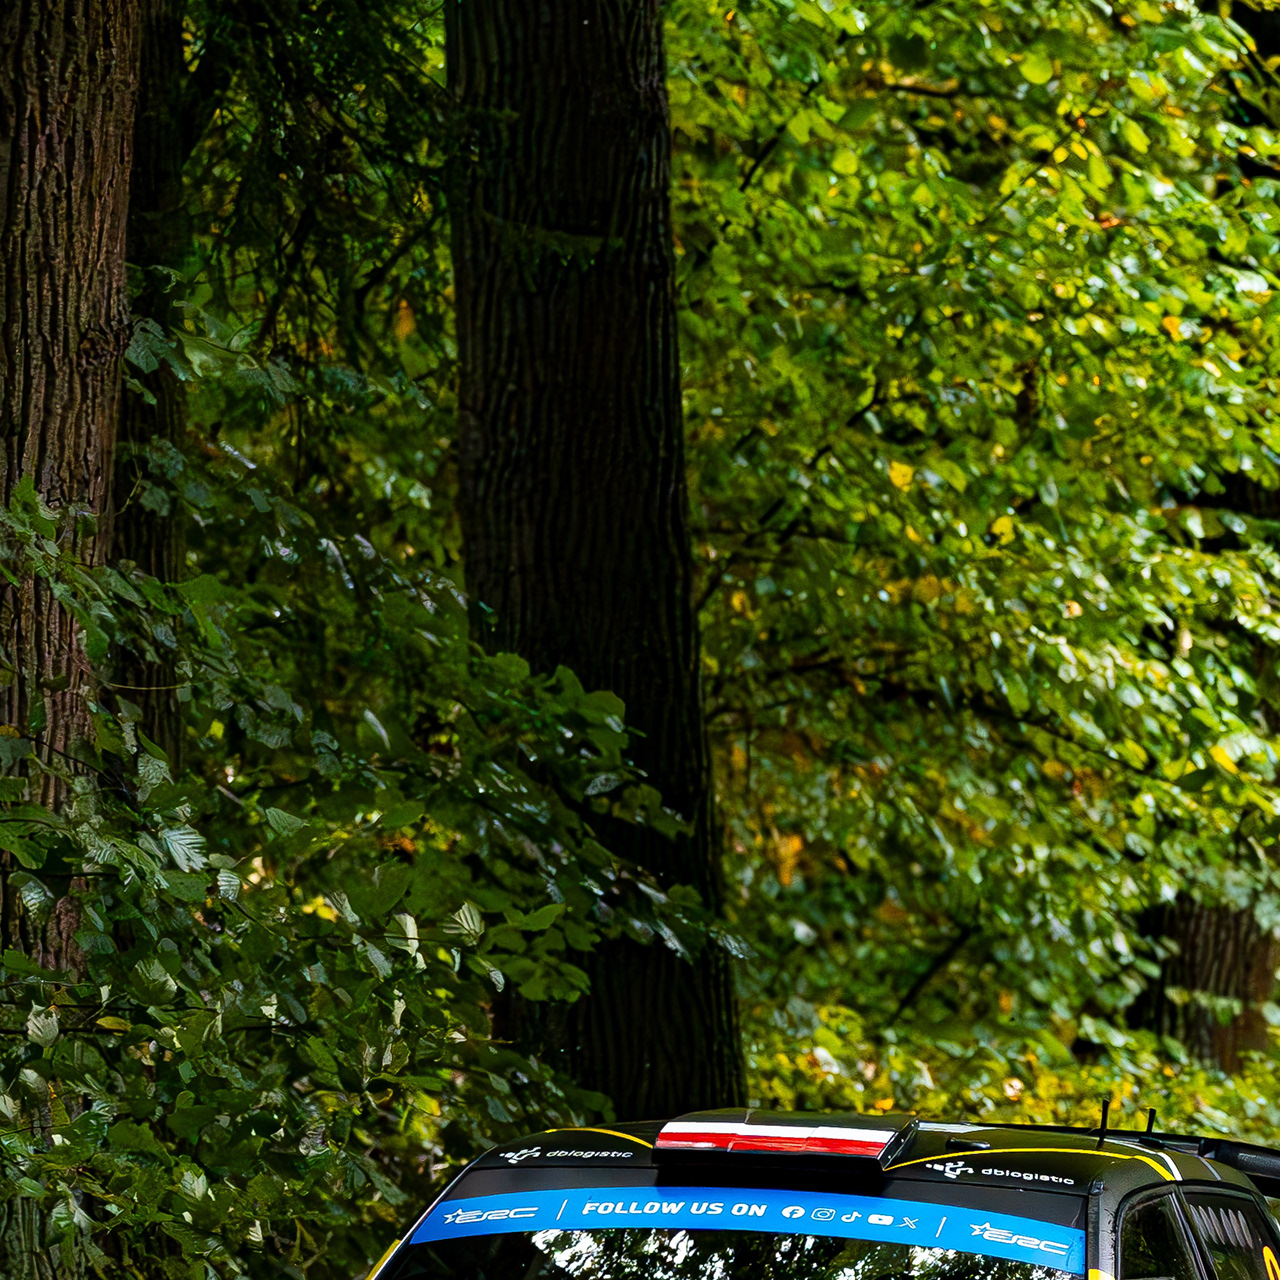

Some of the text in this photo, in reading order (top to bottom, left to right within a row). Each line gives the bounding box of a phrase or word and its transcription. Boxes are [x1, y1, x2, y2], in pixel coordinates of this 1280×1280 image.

[582, 1201, 686, 1216] FOLLOW
[690, 1202, 724, 1216] US
[731, 1203, 768, 1218] ON
